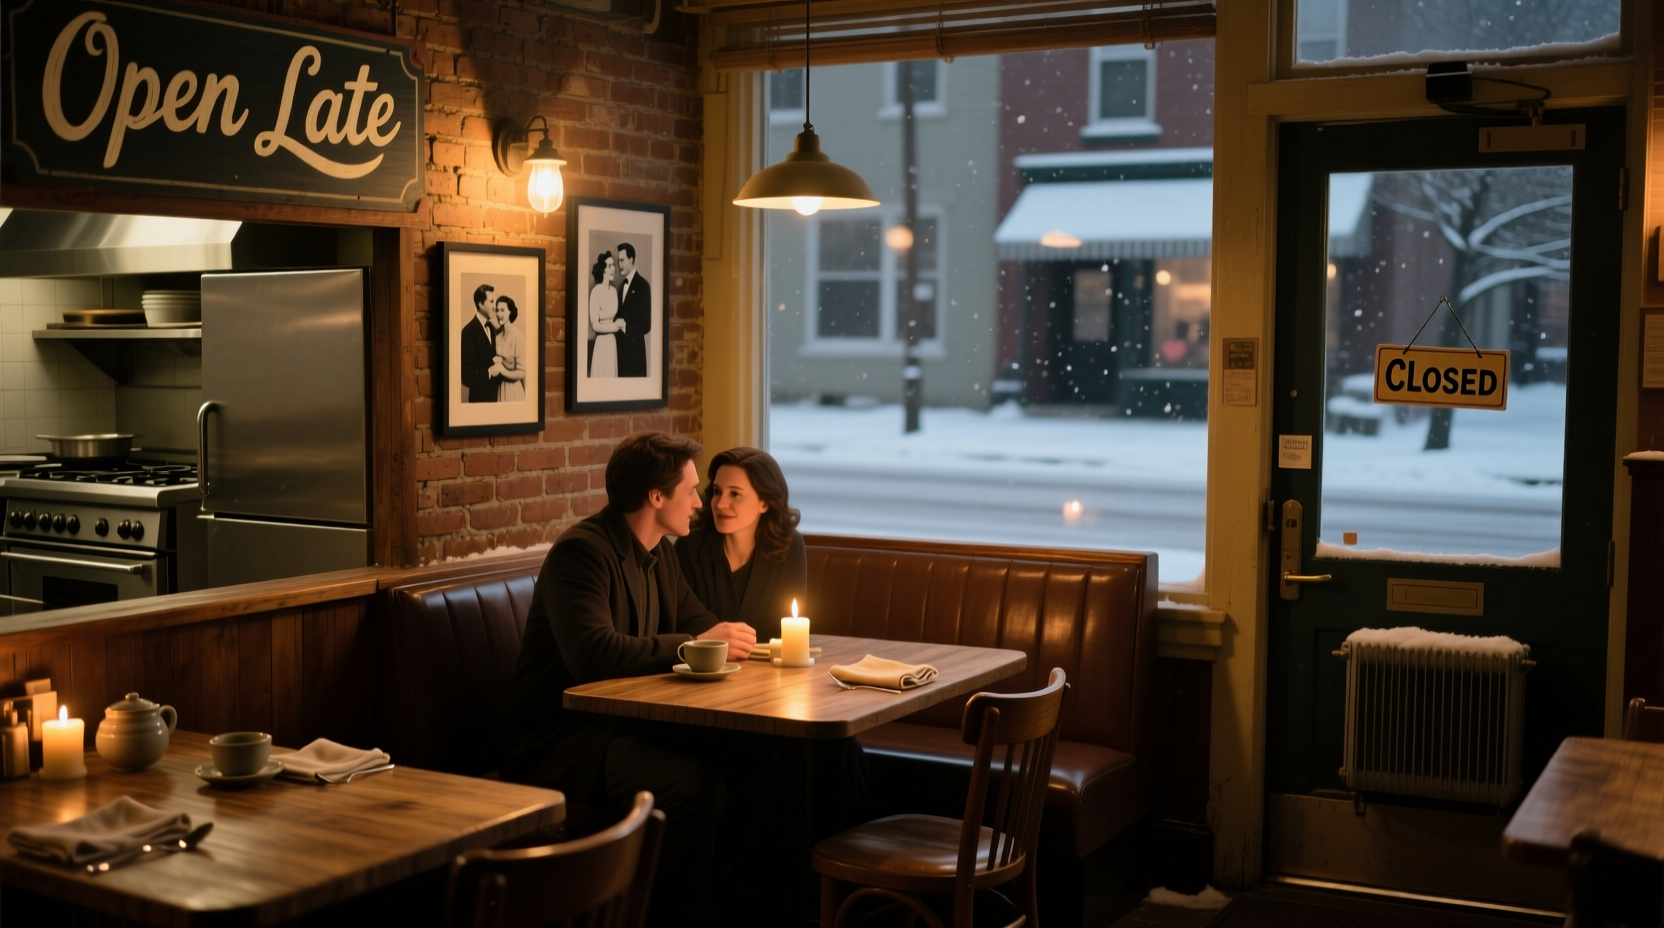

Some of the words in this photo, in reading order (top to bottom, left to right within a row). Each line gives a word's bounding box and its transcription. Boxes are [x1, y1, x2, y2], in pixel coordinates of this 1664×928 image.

[42, 11, 249, 168] Open
[254, 45, 401, 179] Late
[1385, 358, 1498, 396] CLOSED
